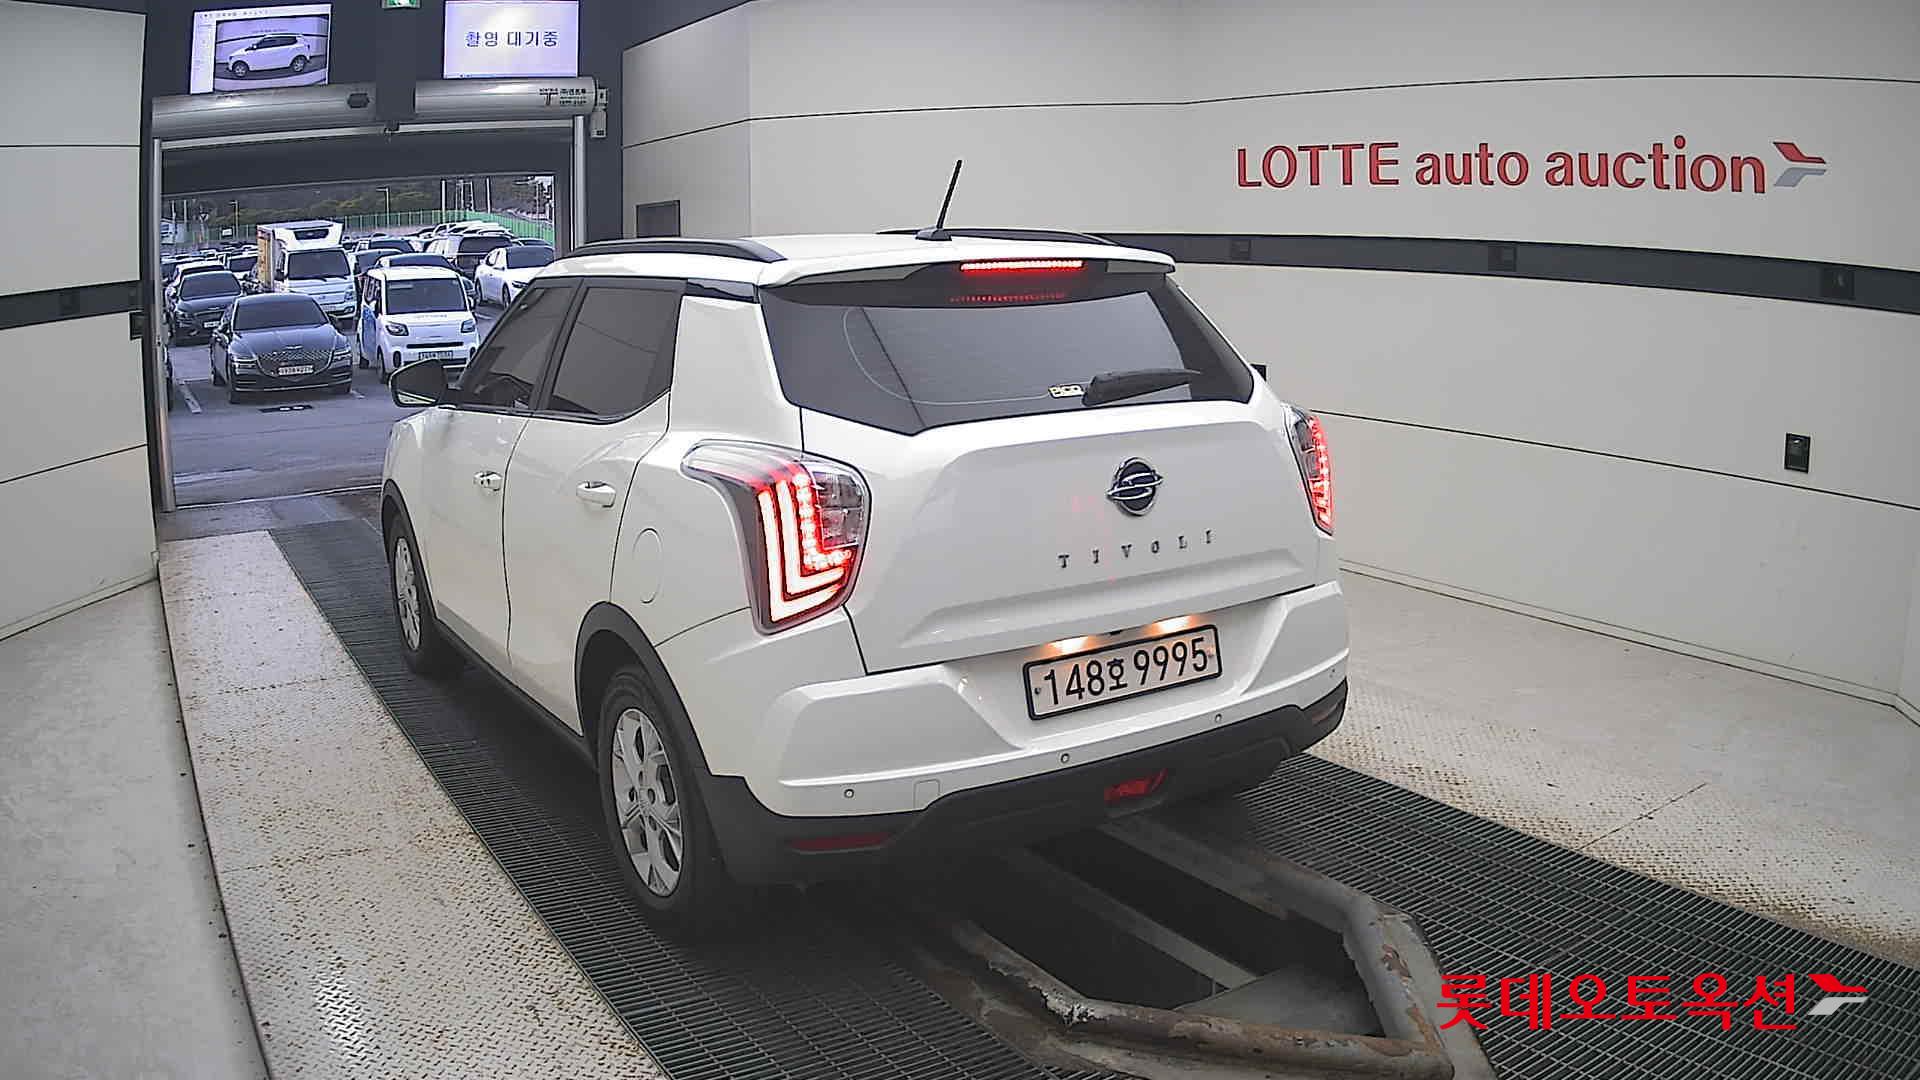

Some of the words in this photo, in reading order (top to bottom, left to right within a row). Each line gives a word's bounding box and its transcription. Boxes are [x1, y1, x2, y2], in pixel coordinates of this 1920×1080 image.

[507, 31, 558, 47] 대기중
[1237, 142, 1400, 188] LOTTE
[1415, 142, 1529, 186] auto
[1545, 134, 1765, 194] auction
[1058, 529, 1213, 569] TIVOLI
